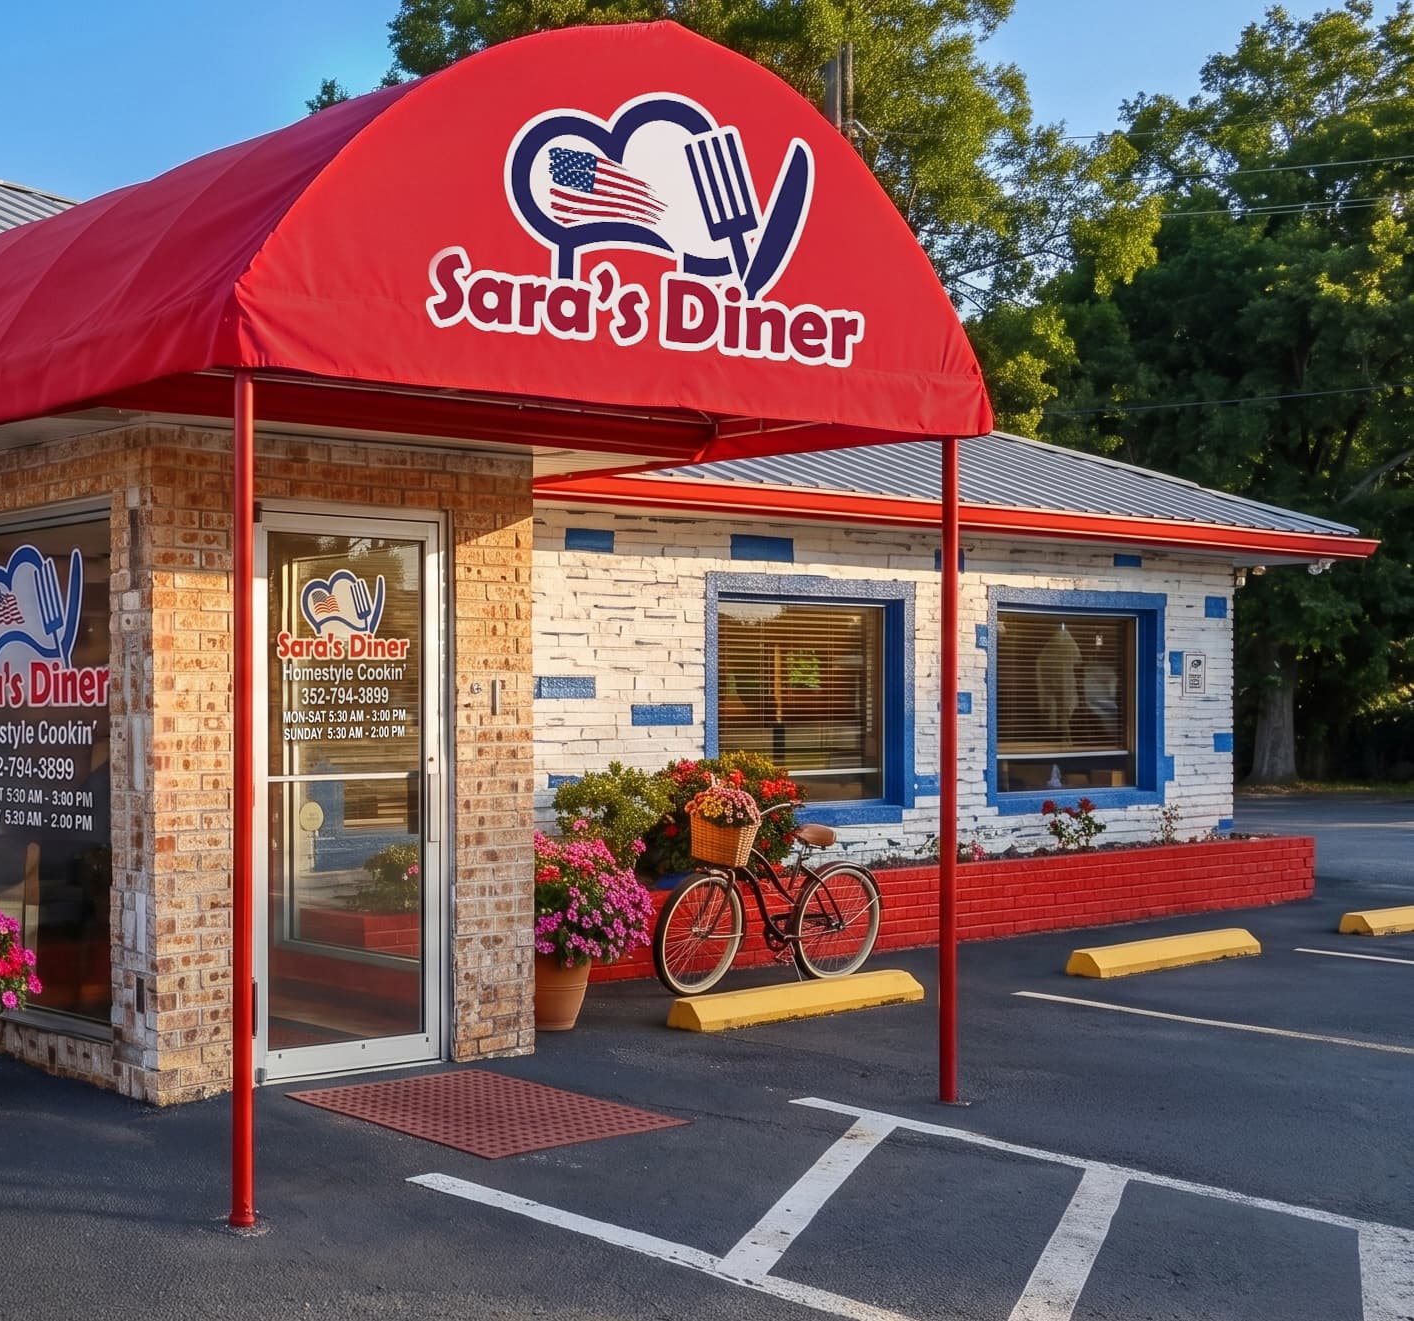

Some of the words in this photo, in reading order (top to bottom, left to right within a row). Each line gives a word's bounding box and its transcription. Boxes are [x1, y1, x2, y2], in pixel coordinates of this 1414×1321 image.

[431, 250, 645, 341] Sara's
[664, 276, 861, 362] Diner
[278, 632, 343, 658] Sara's
[349, 633, 408, 658] Diner
[29, 660, 110, 706] Diner
[283, 664, 354, 684] Homestyle
[357, 663, 406, 681] Cookin'
[301, 686, 389, 705] 352-794-3899
[282, 710, 326, 723] MON-SAT
[328, 710, 347, 723] 5:30
[349, 709, 364, 722] AM
[372, 709, 390, 721] 3:00
[392, 709, 406, 721] PM
[38, 720, 97, 745] Cookin'
[284, 727, 323, 740] SUNDAY
[327, 727, 346, 739] 5:30
[348, 726, 363, 739] AM
[370, 725, 389, 738] 2:00
[391, 725, 405, 737] PM
[27, 789, 43, 804] AM
[75, 791, 93, 808] PM
[26, 811, 42, 826] AM
[75, 814, 92, 831] PM
